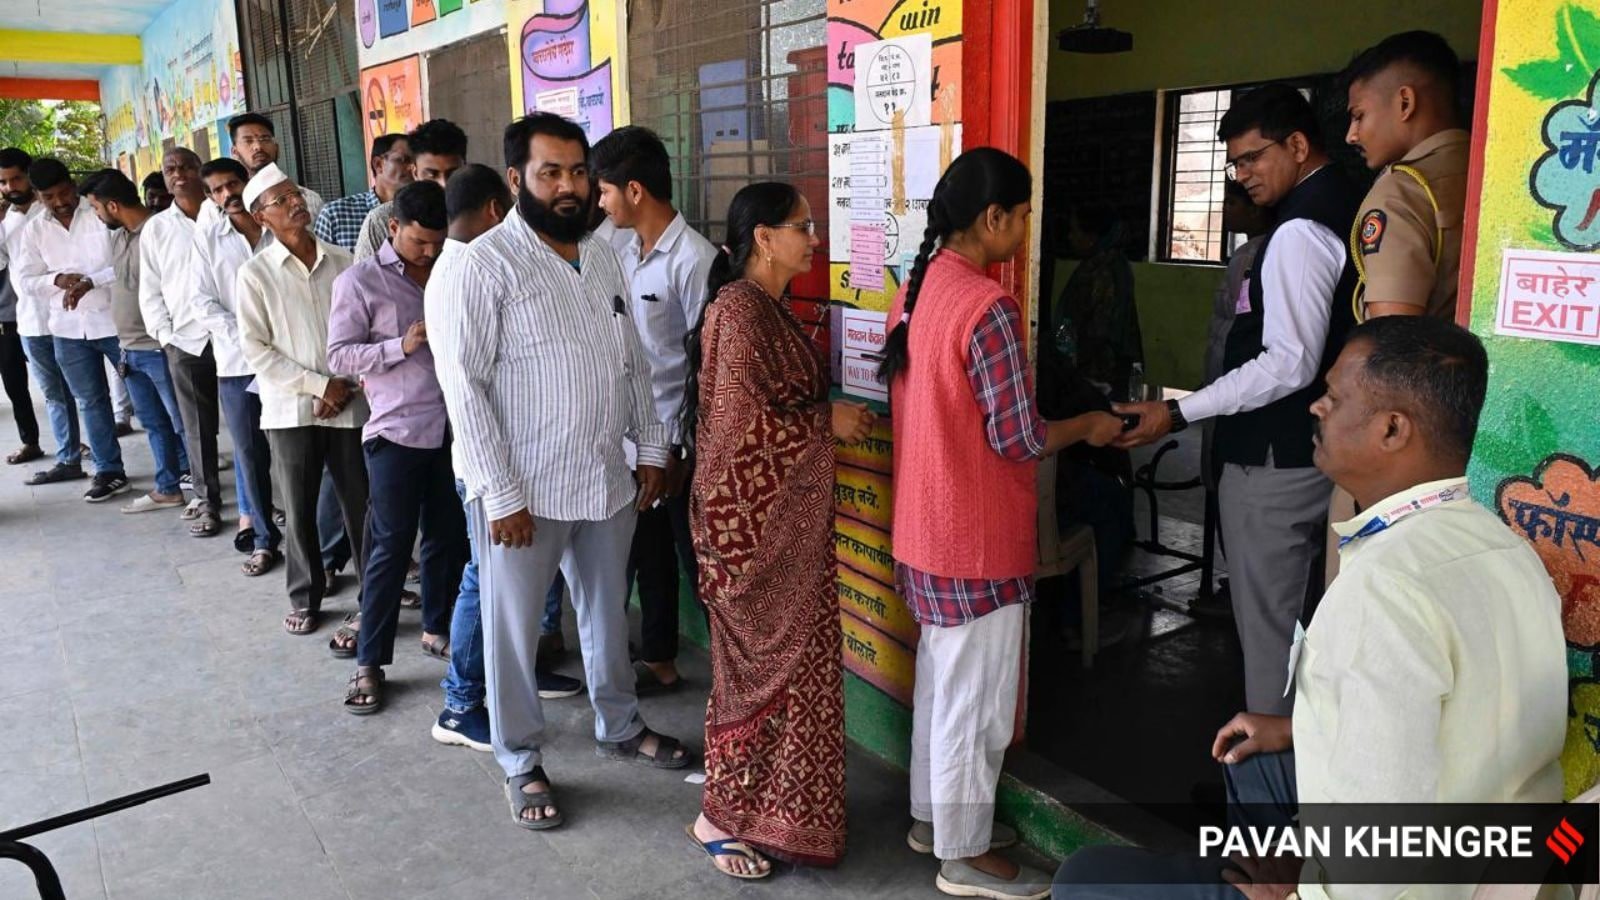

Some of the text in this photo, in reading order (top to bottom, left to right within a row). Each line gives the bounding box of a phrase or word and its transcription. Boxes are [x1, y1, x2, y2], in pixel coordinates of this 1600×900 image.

[899, 1, 941, 31] win
[837, 41, 856, 70] ta
[1515, 265, 1595, 298] बाहेर
[1511, 300, 1594, 332] EXIT
[847, 365, 860, 380] WAY
[860, 367, 870, 382] TO
